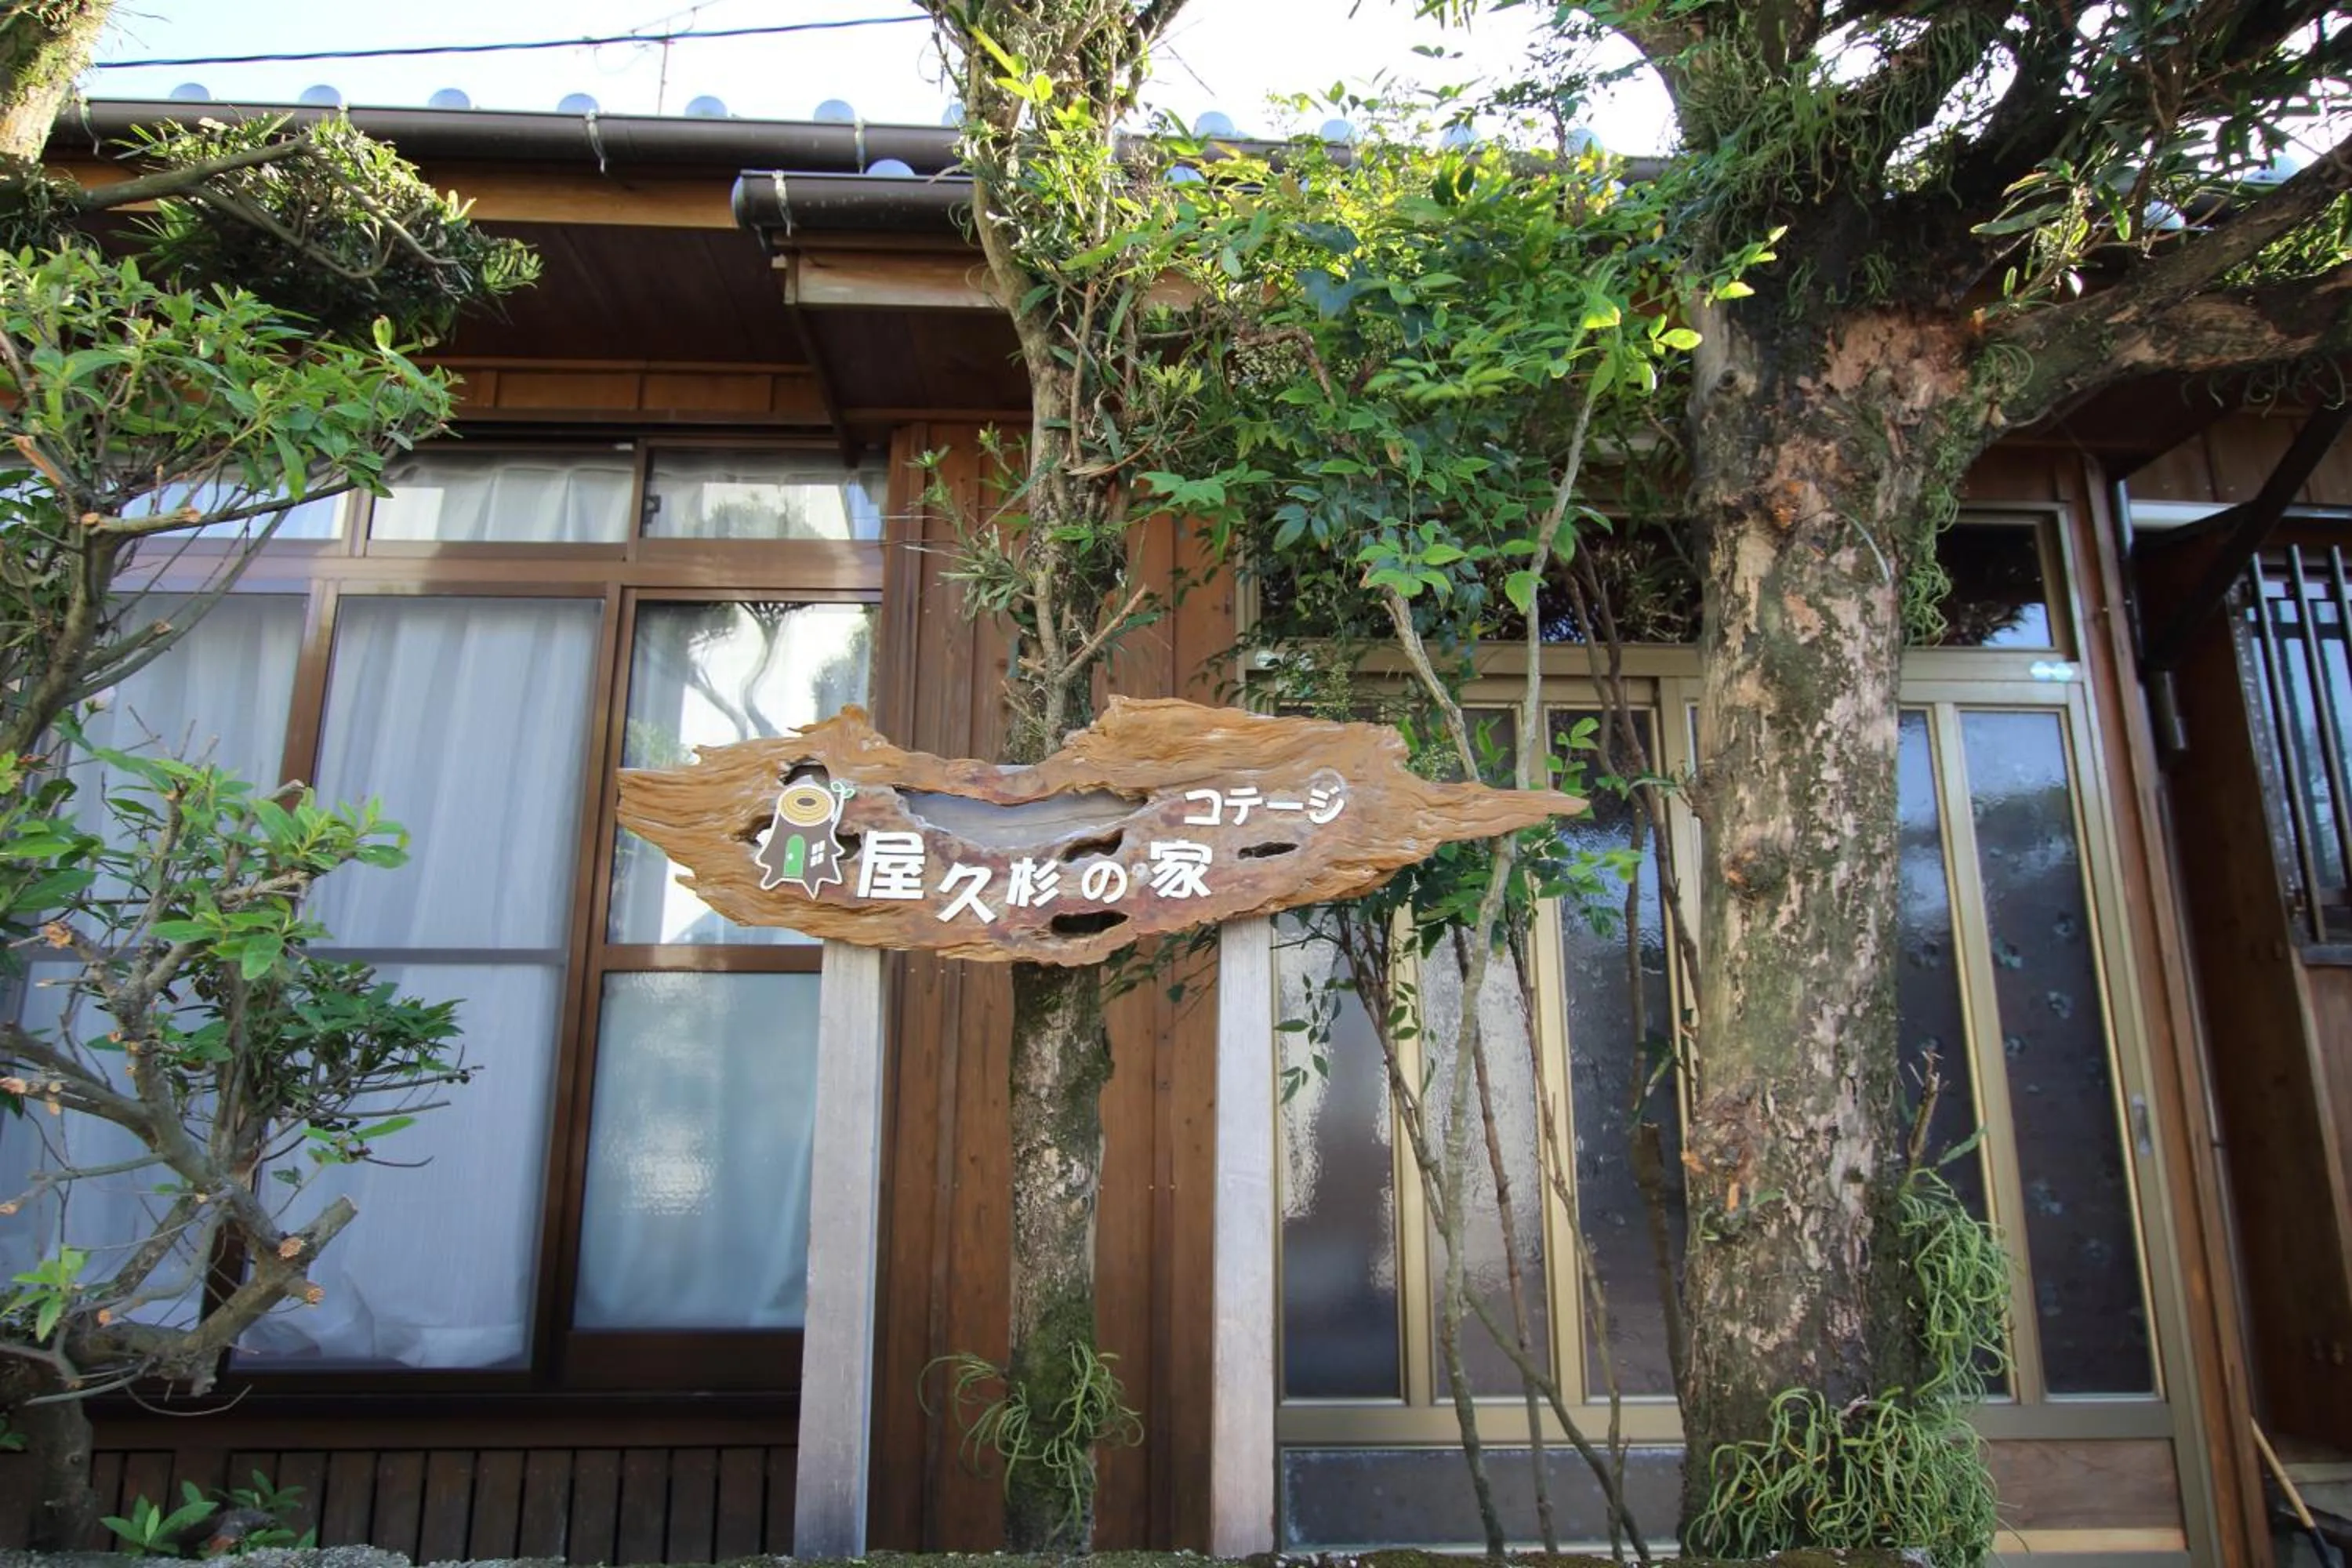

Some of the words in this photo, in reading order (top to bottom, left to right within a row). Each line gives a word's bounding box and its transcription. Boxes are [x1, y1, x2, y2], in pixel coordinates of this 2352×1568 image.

[1184, 786, 1345, 826] コテージ
[857, 830, 1213, 924] 屋久杉の家
